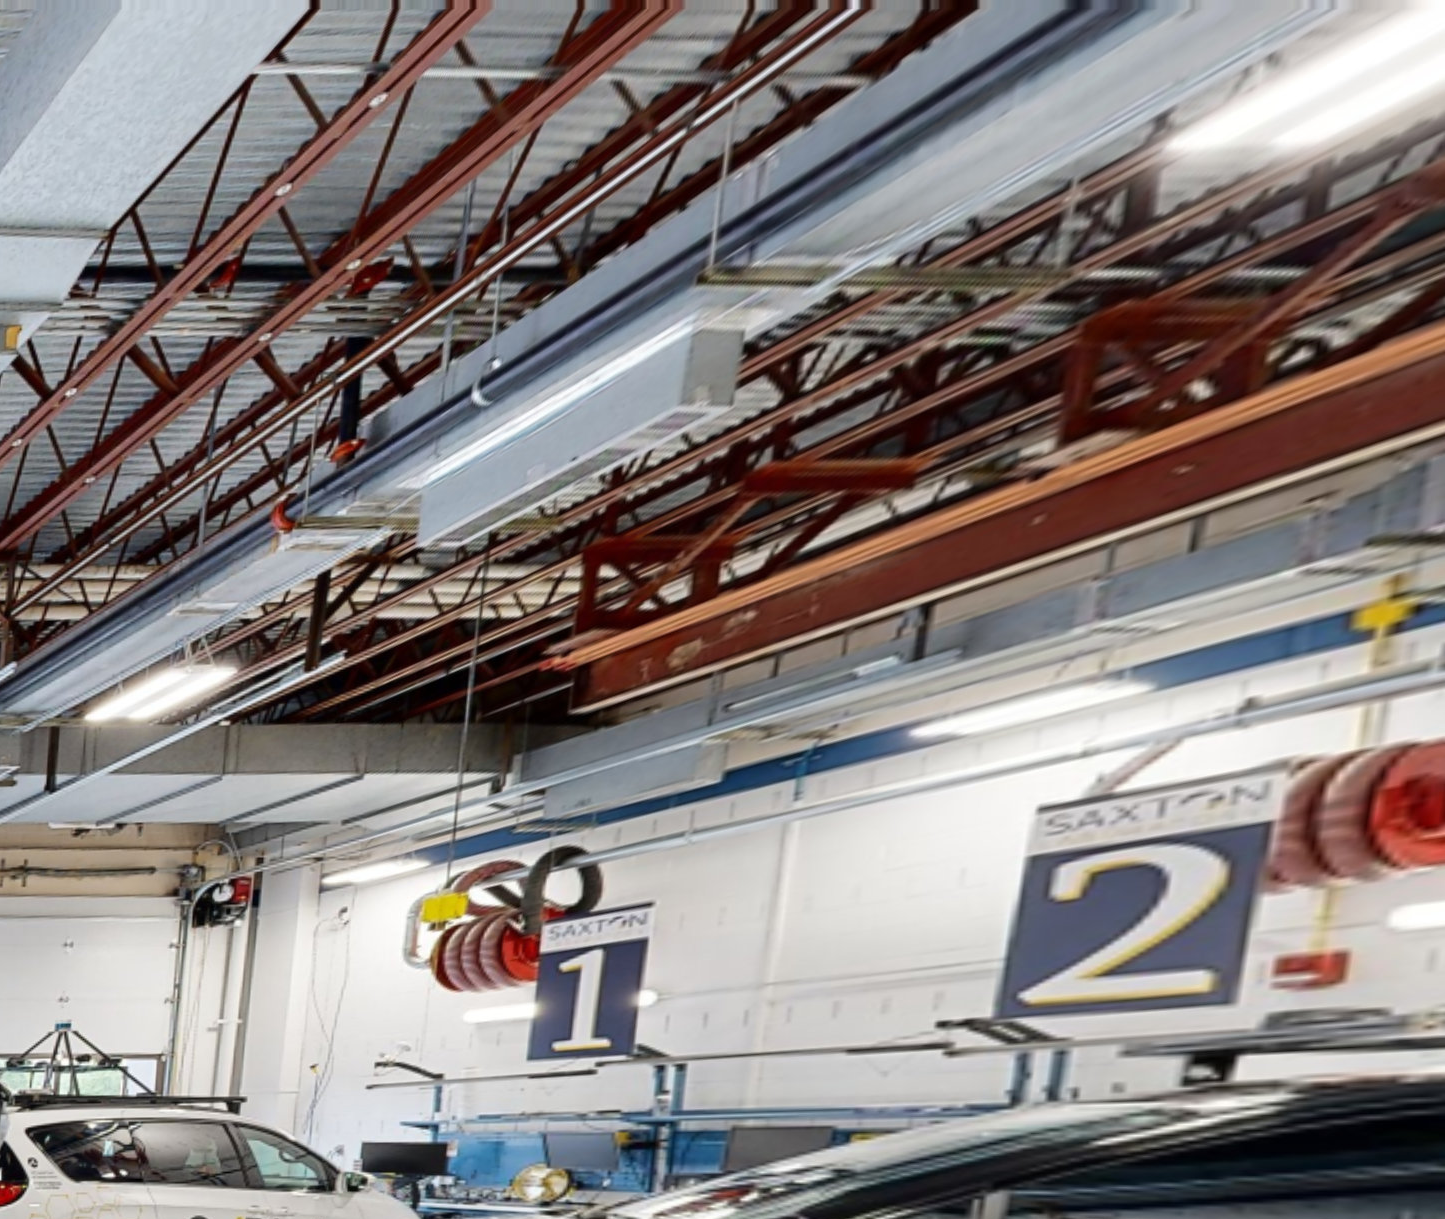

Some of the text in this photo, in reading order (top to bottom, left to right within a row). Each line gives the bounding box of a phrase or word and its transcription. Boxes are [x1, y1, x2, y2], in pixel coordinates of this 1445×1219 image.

[1045, 779, 1273, 837] SAXTON
[549, 912, 649, 940] SAXTON
[1017, 843, 1230, 1006] 2
[551, 949, 611, 1051] 1
